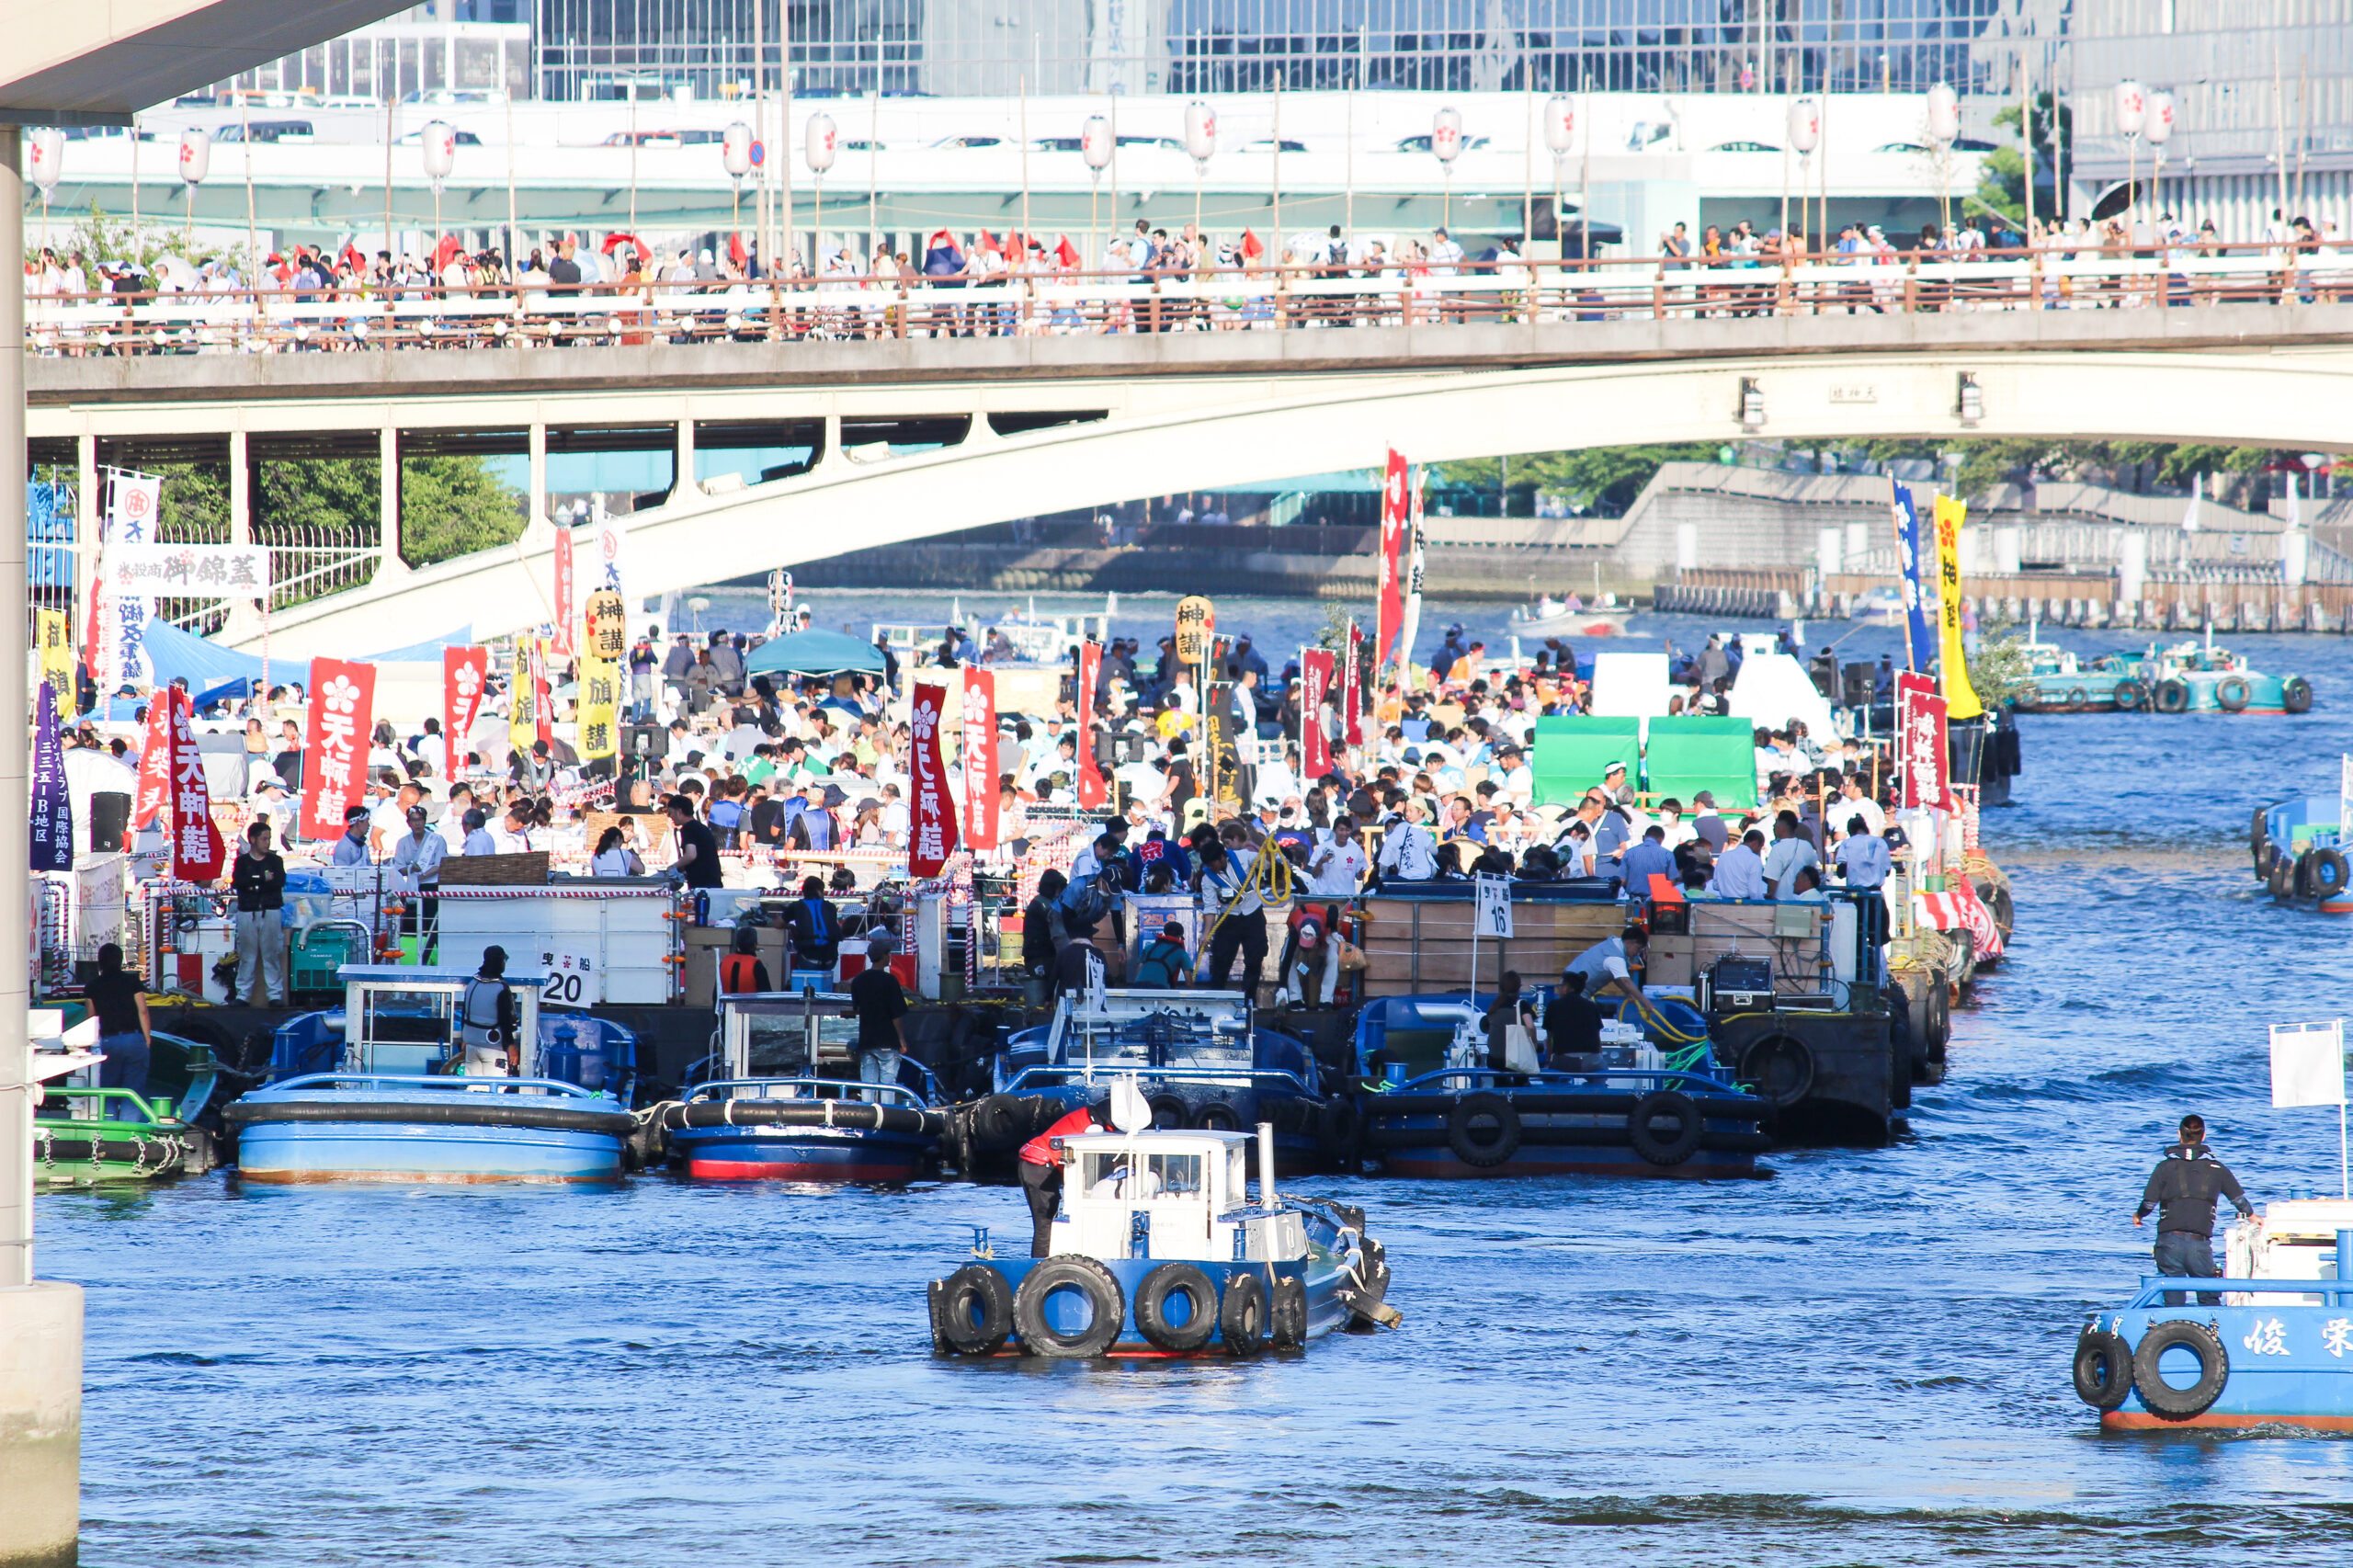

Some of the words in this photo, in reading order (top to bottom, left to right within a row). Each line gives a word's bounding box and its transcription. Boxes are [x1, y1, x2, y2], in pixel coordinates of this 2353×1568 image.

[163, 554, 258, 586] 御錦蓋
[597, 598, 623, 653] 榊講
[1177, 603, 1204, 655] 榊講
[1491, 904, 1506, 934] 16
[543, 971, 582, 1003] 20
